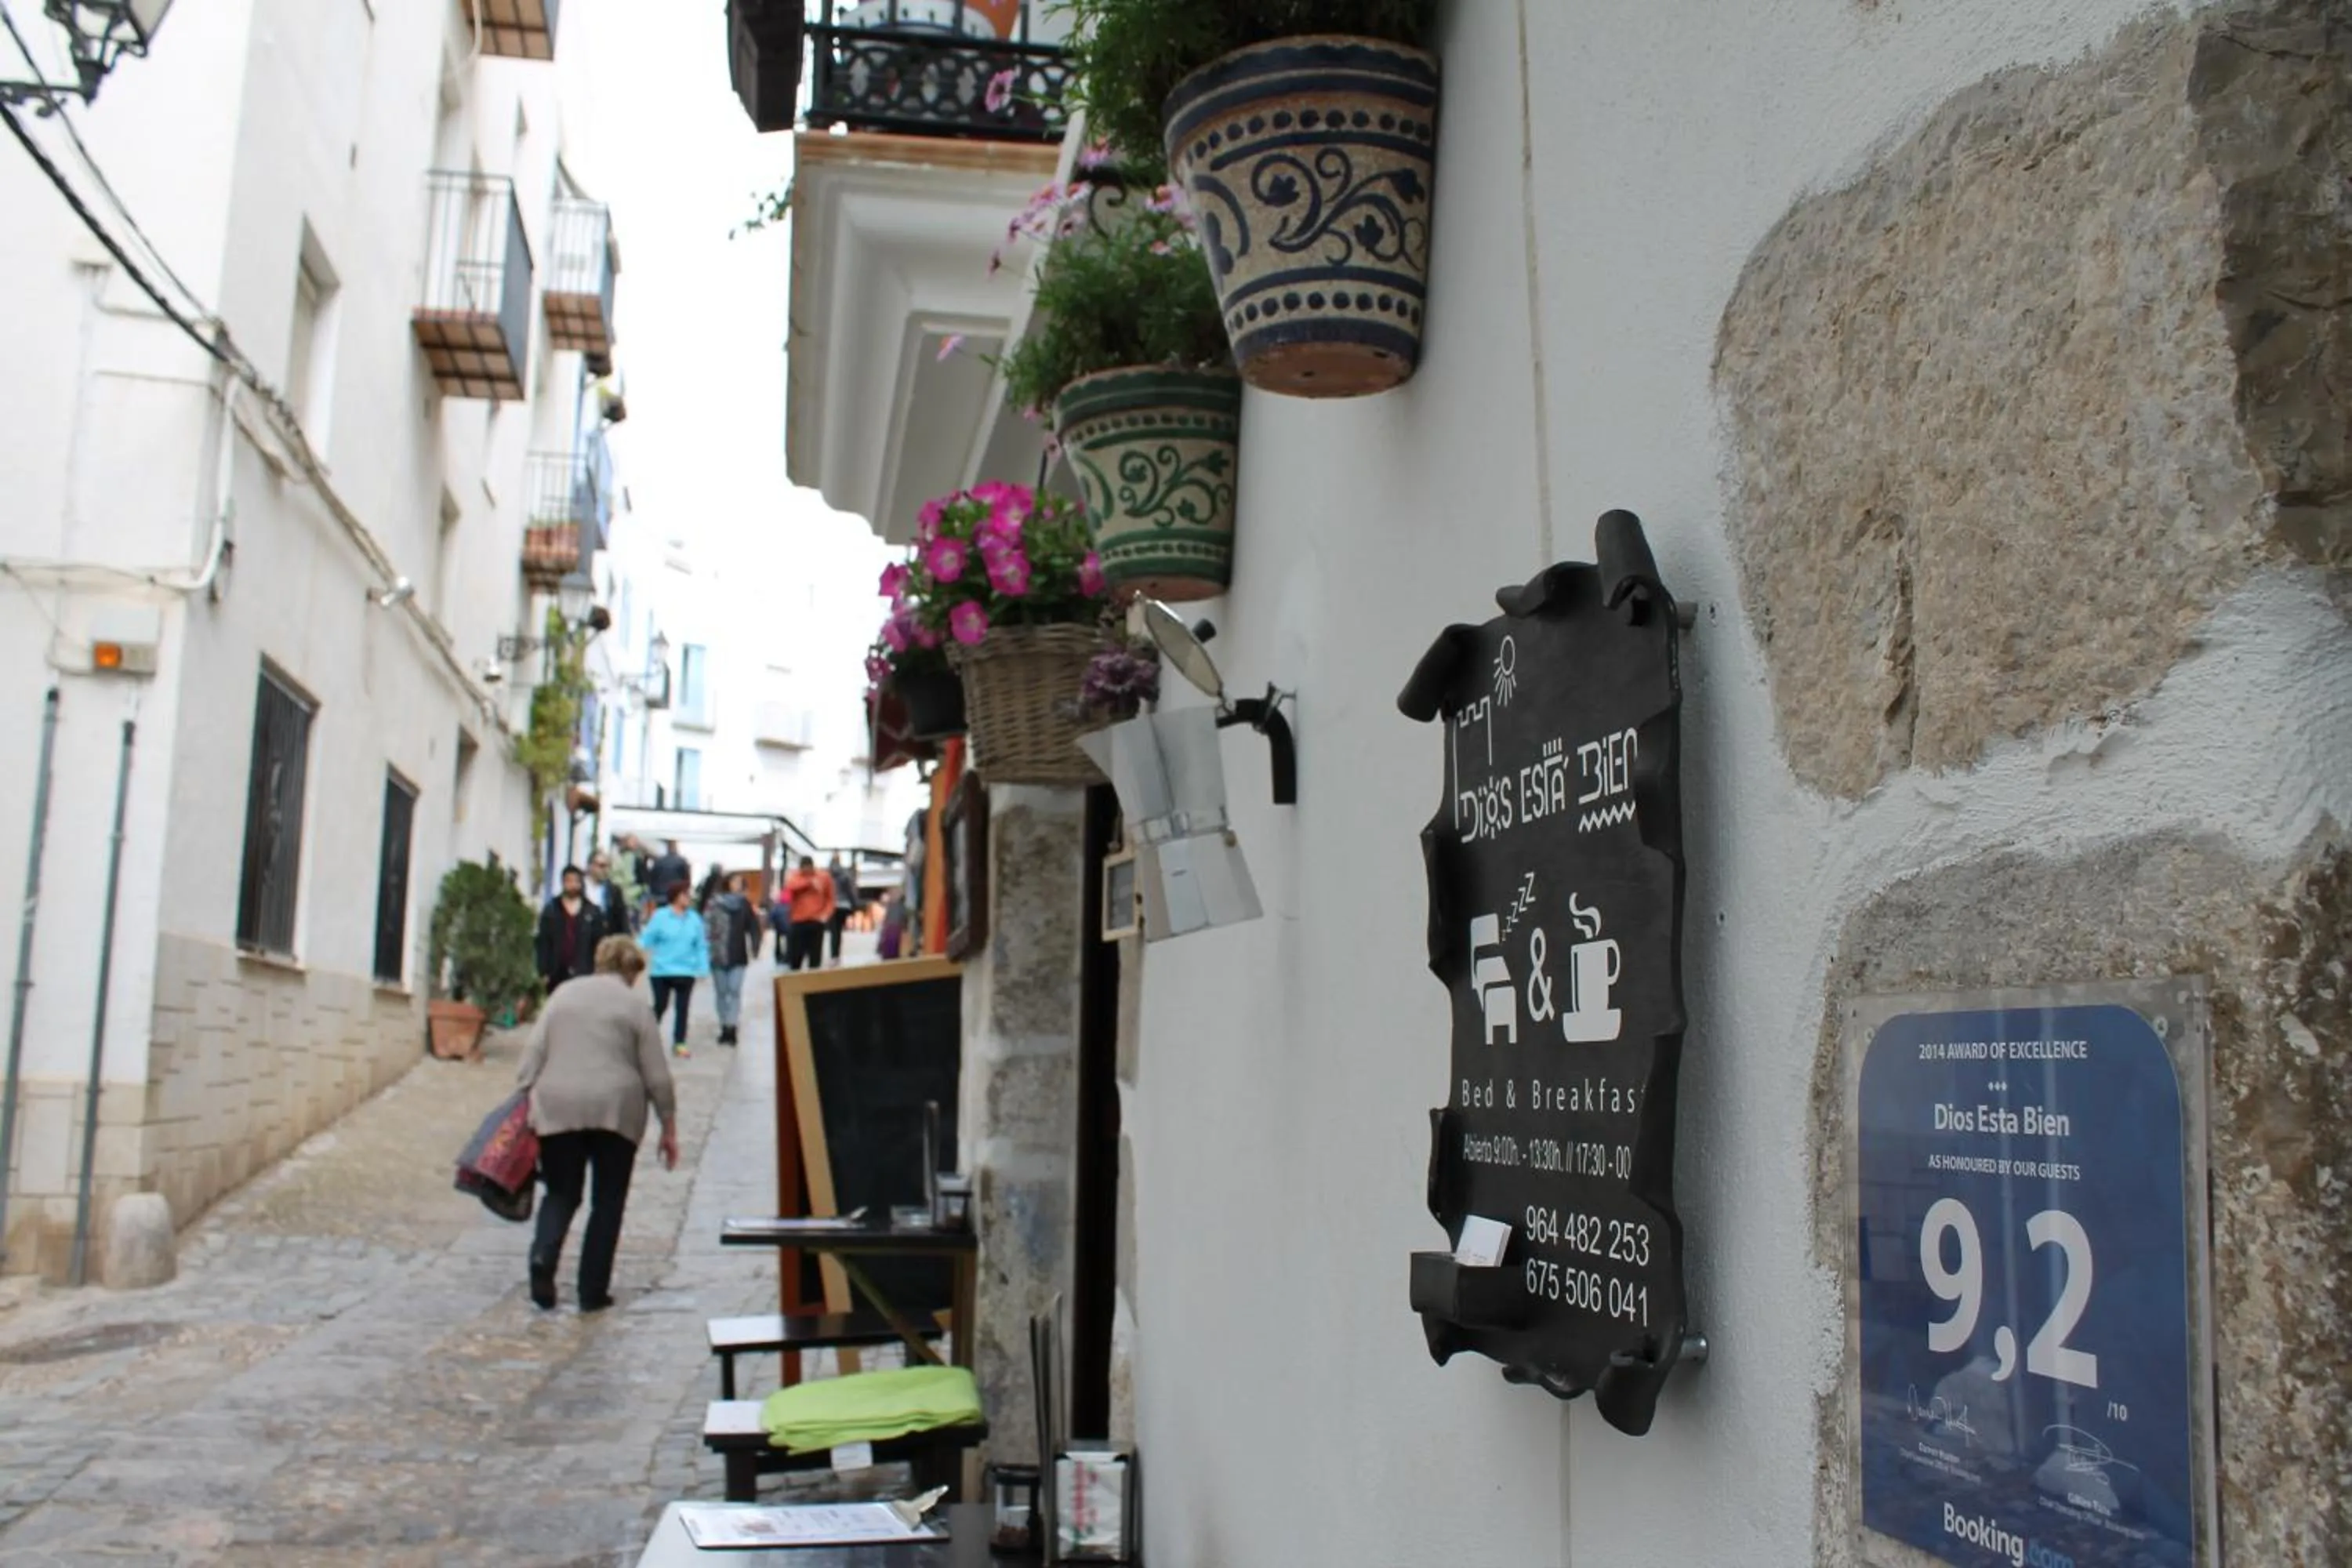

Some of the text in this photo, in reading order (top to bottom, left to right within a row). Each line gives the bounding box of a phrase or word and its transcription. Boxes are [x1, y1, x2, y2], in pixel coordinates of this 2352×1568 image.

[1527, 927, 1555, 1022] &
[1918, 1040, 2089, 1060] 2014 AWARD OF EXCELLENCE
[1462, 1077, 1646, 1113] Bed & Breakfas
[1934, 1103, 2070, 1136] Dios Esta Bien
[1463, 1134, 1492, 1163] Abierto
[1576, 1142, 1606, 1177] 17:30
[1928, 1153, 2082, 1181] AS HONOURED BY OUR GUESTS
[1526, 1204, 1650, 1267] 964 482 253
[1526, 1258, 1648, 1327] 675 506 041
[1919, 1197, 2099, 1388] 9,2
[2107, 1399, 2128, 1422] /10
